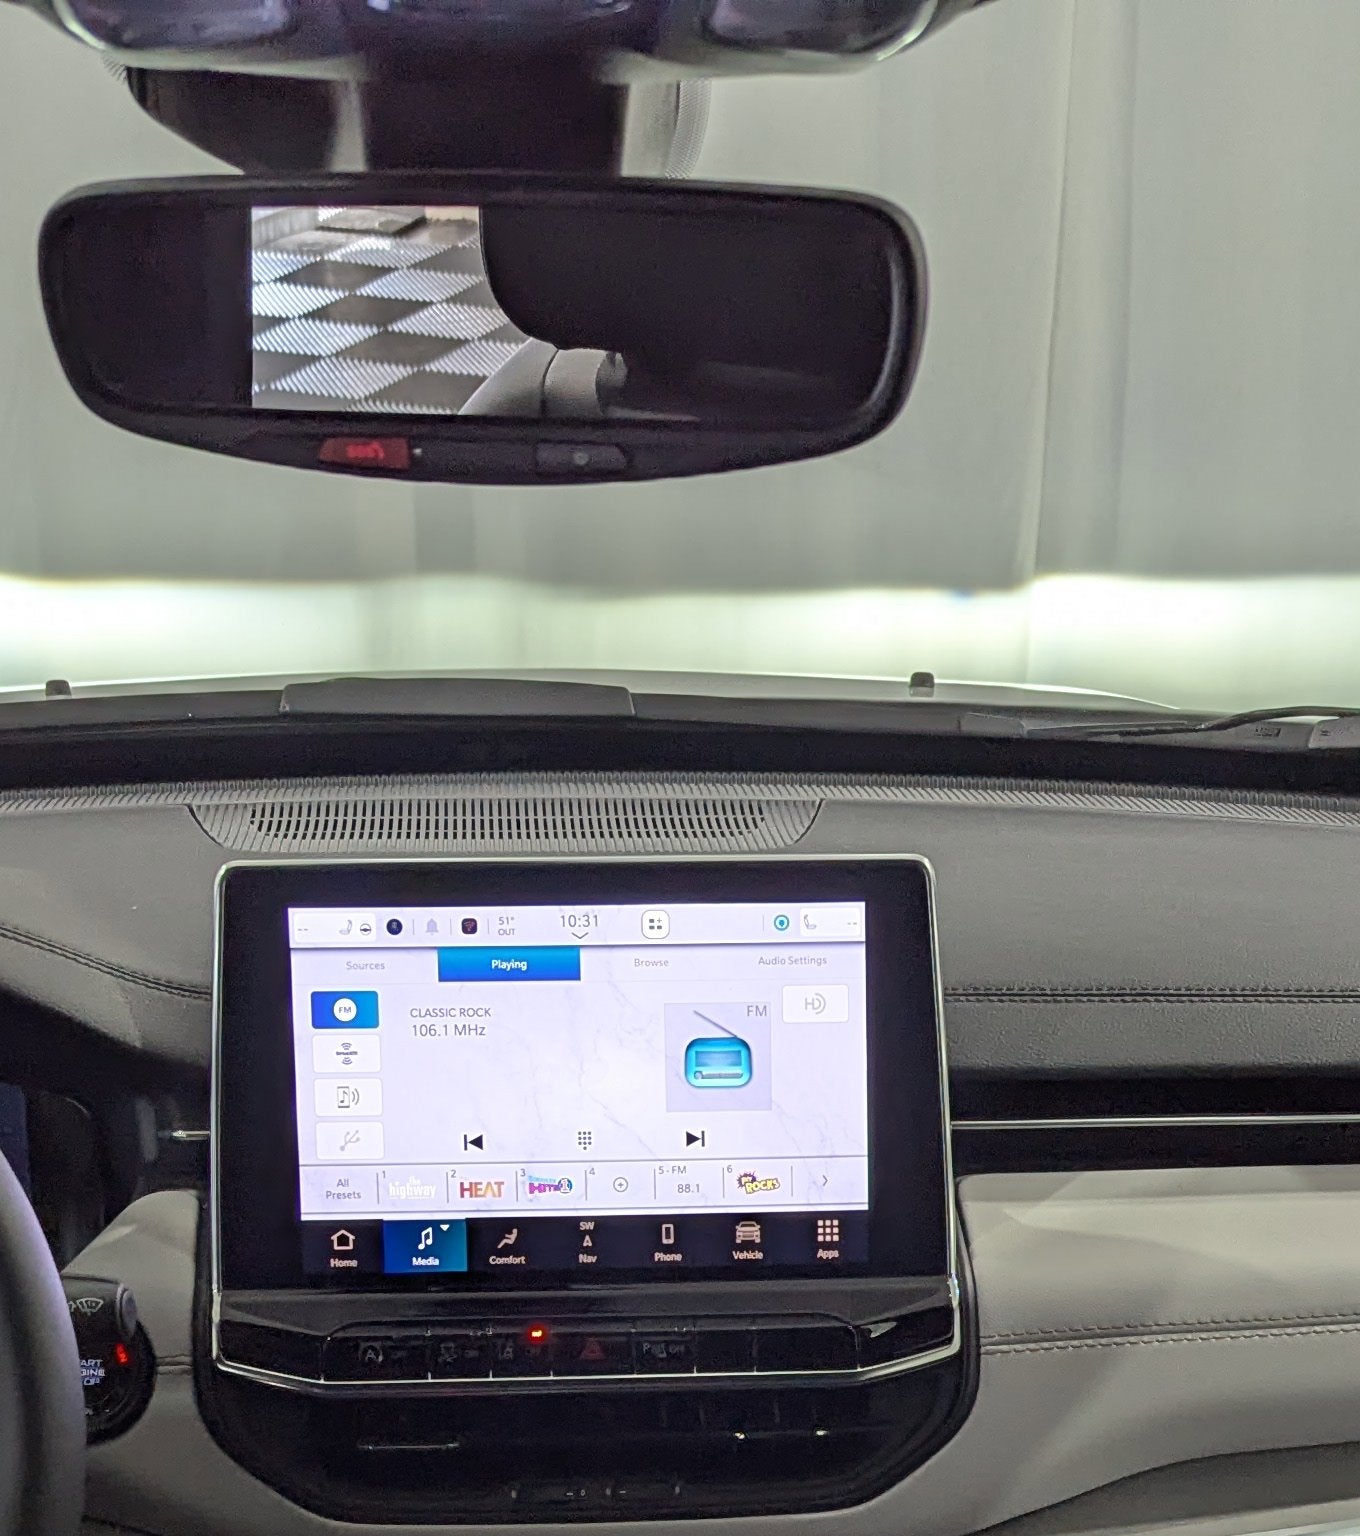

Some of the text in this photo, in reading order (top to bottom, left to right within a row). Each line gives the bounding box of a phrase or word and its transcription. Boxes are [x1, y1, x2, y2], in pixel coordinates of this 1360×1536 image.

[559, 914, 599, 928] 10:31
[498, 928, 515, 937] OUT
[346, 960, 385, 970] Sources
[491, 959, 528, 971] Playing
[634, 957, 669, 967] Browse
[758, 955, 828, 967] Audio Settings
[338, 1006, 352, 1014] FM
[410, 1007, 491, 1018] CLASSIC ROCK
[746, 1005, 767, 1017] FM
[411, 1024, 487, 1037] 106.1 MHz
[520, 1168, 526, 1177] 3
[589, 1167, 596, 1176] 4
[658, 1166, 664, 1175] 5
[671, 1165, 687, 1175] FM
[726, 1164, 733, 1174] 6
[382, 1171, 387, 1179] 1
[450, 1170, 457, 1179] 2
[336, 1178, 349, 1188] All
[745, 1178, 780, 1194] ROCKS
[389, 1183, 437, 1200] highway
[460, 1181, 505, 1199] HEAT
[677, 1183, 700, 1194] 88.1
[325, 1190, 361, 1200] Presets
[580, 1222, 594, 1231] SW
[579, 1254, 597, 1264] Nav
[654, 1252, 682, 1262] Phone
[732, 1250, 764, 1260] Vehicle
[817, 1249, 839, 1259] Apps
[331, 1258, 358, 1268] Home
[412, 1256, 440, 1266] Media
[489, 1255, 526, 1265] Comfort
